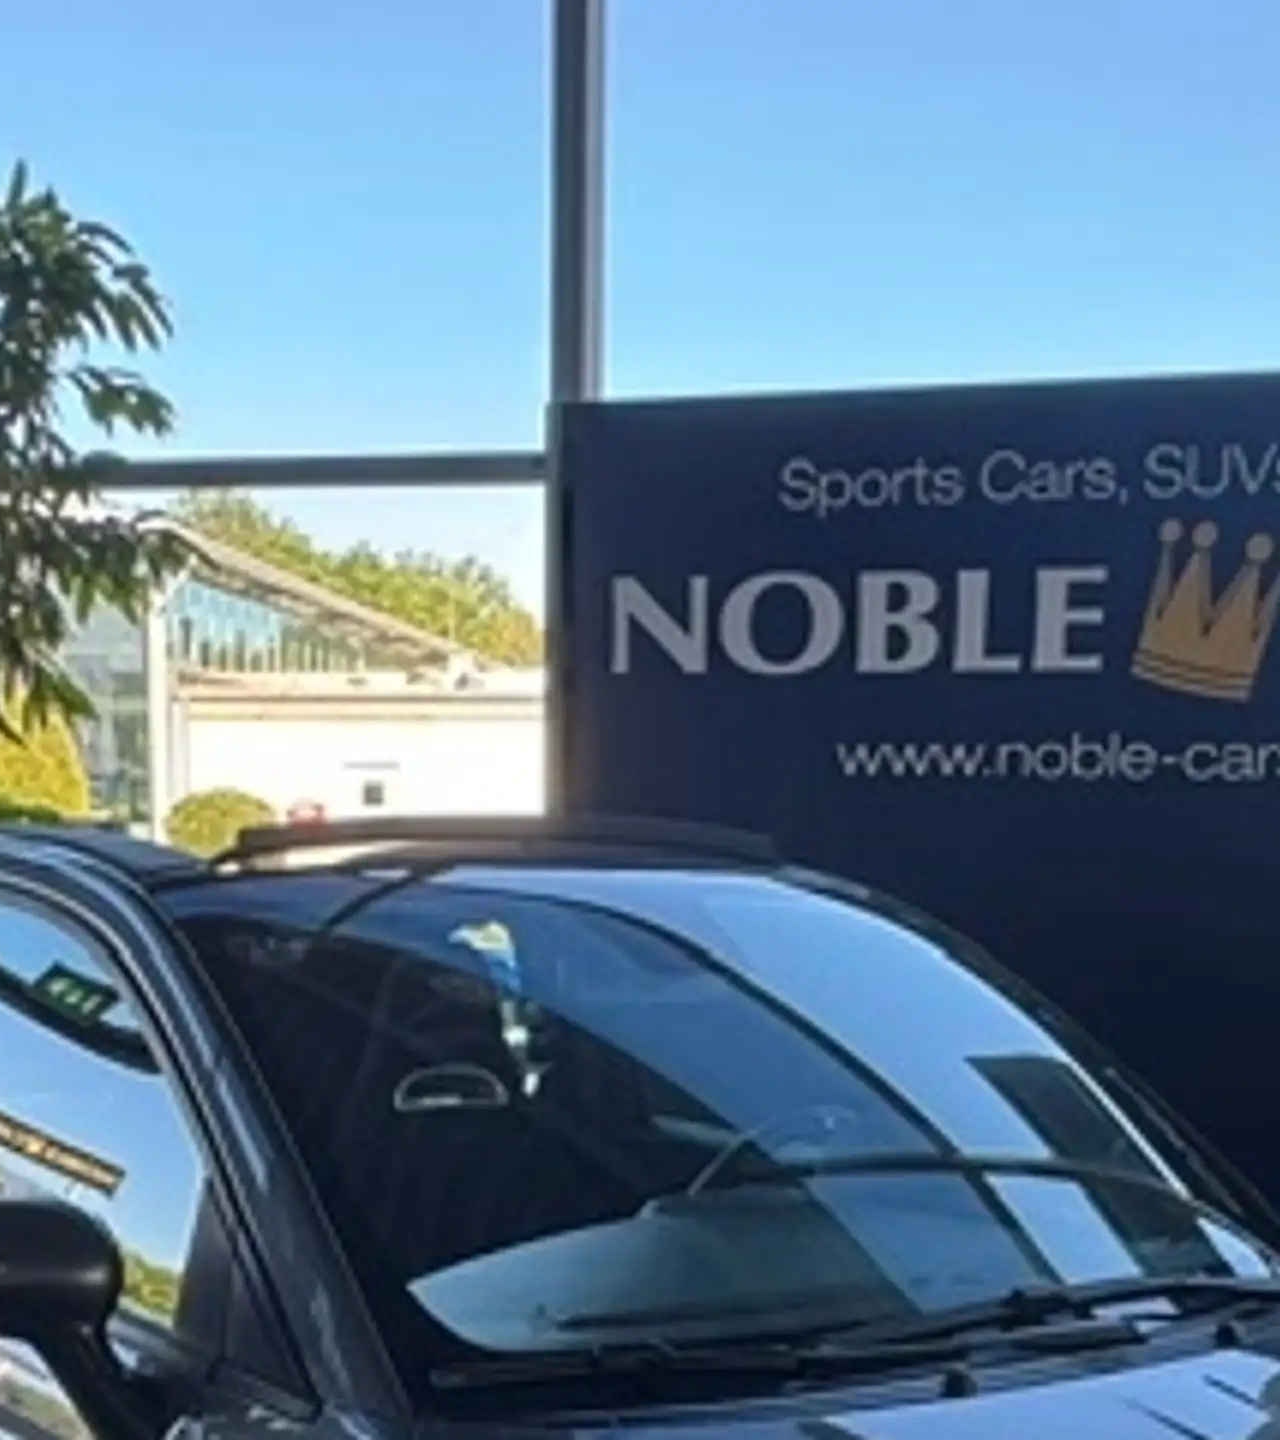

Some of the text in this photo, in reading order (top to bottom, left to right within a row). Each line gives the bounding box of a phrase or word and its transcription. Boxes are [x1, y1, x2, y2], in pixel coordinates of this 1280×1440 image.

[778, 455, 966, 518] Sports
[980, 449, 1129, 504] Cars,
[609, 564, 1110, 676] NOBLE
